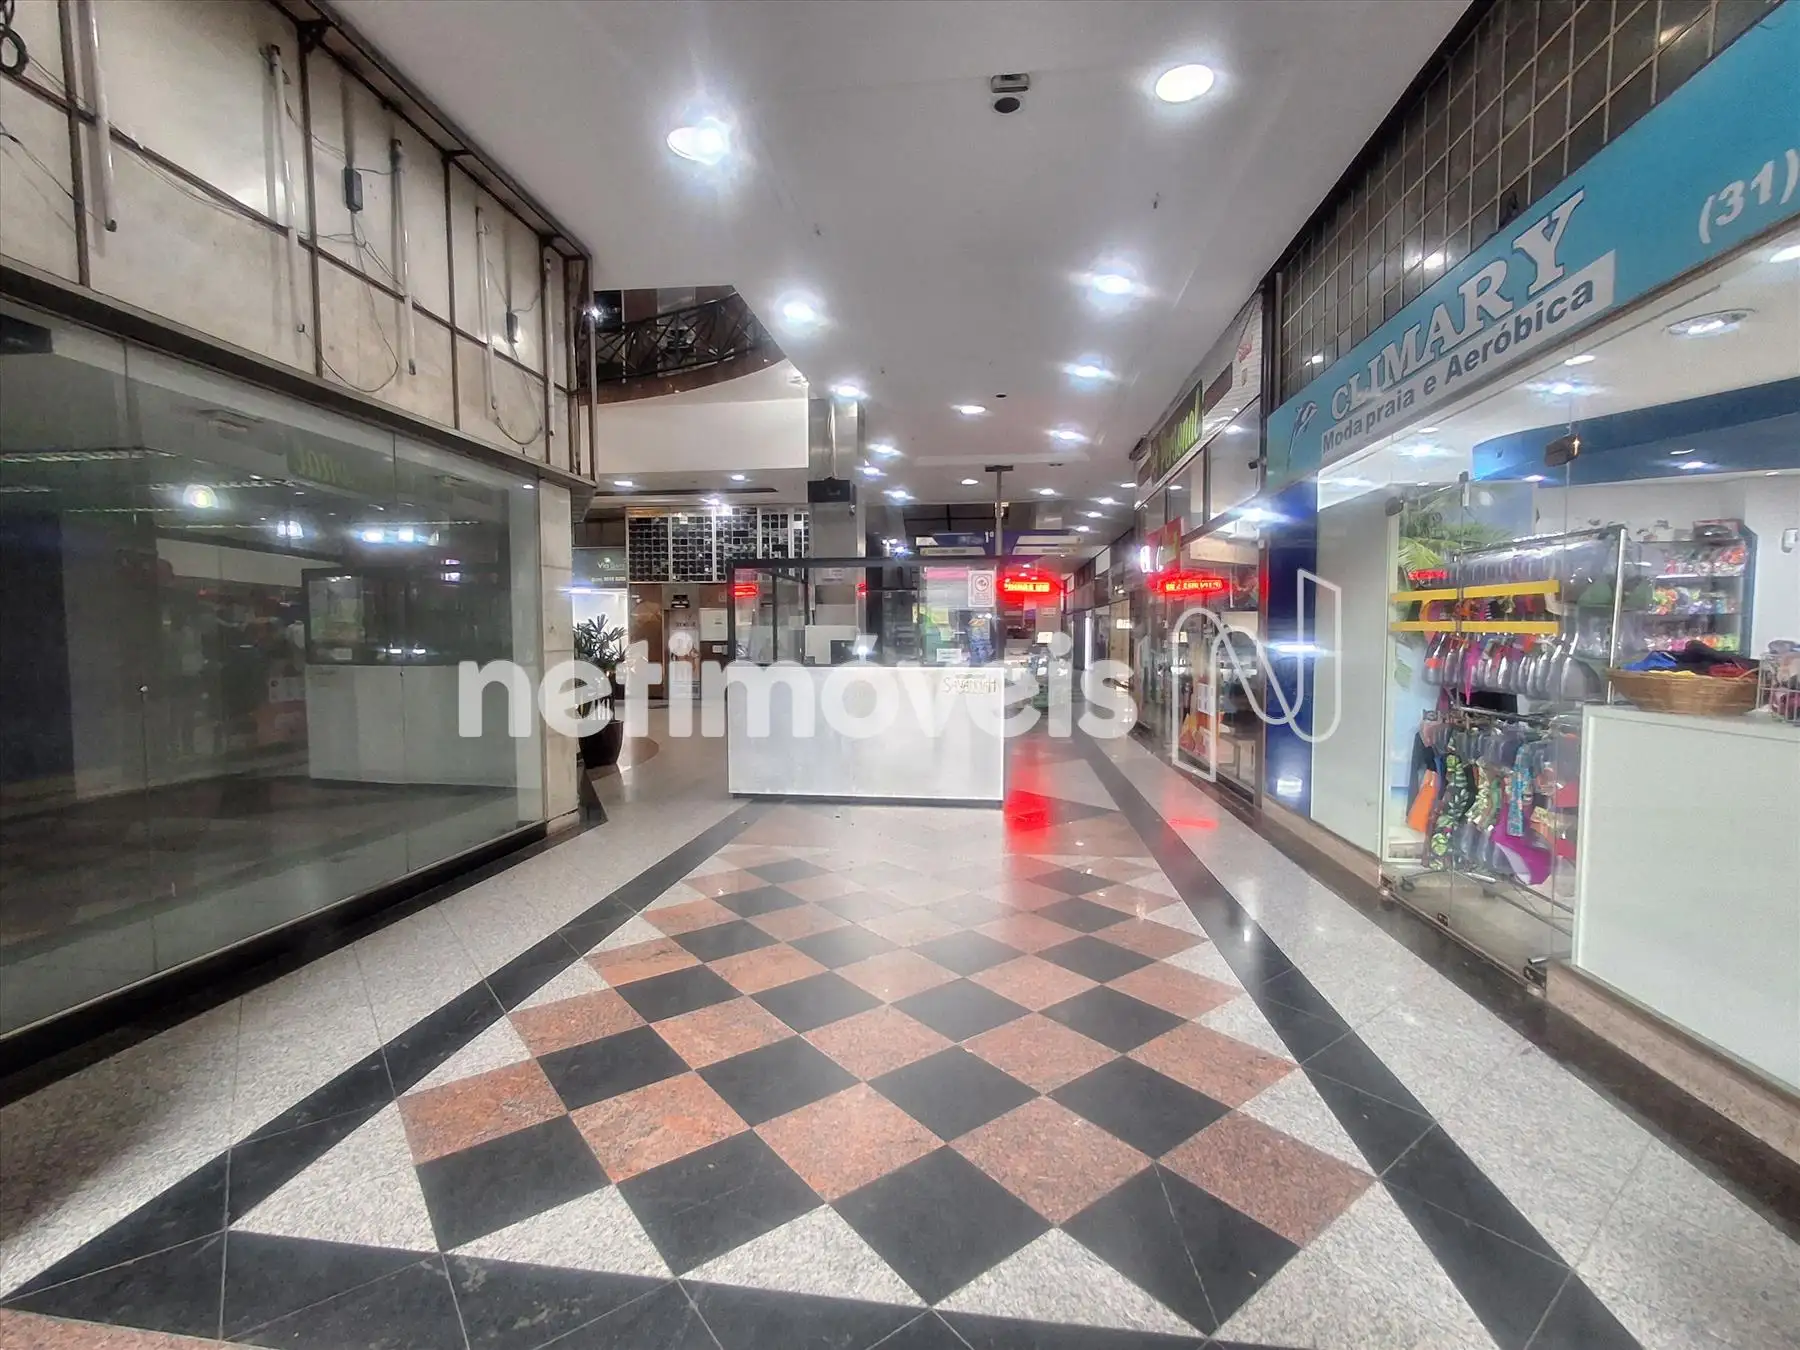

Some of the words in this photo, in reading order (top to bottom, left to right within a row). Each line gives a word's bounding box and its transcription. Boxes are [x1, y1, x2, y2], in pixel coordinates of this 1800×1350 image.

[1698, 148, 1799, 244] (31)
[1322, 417, 1363, 454] Moda
[1365, 387, 1415, 435] praia
[1423, 375, 1437, 396] e
[1445, 279, 1593, 386] Aeróbica
[1330, 186, 1585, 422] CLIMARY
